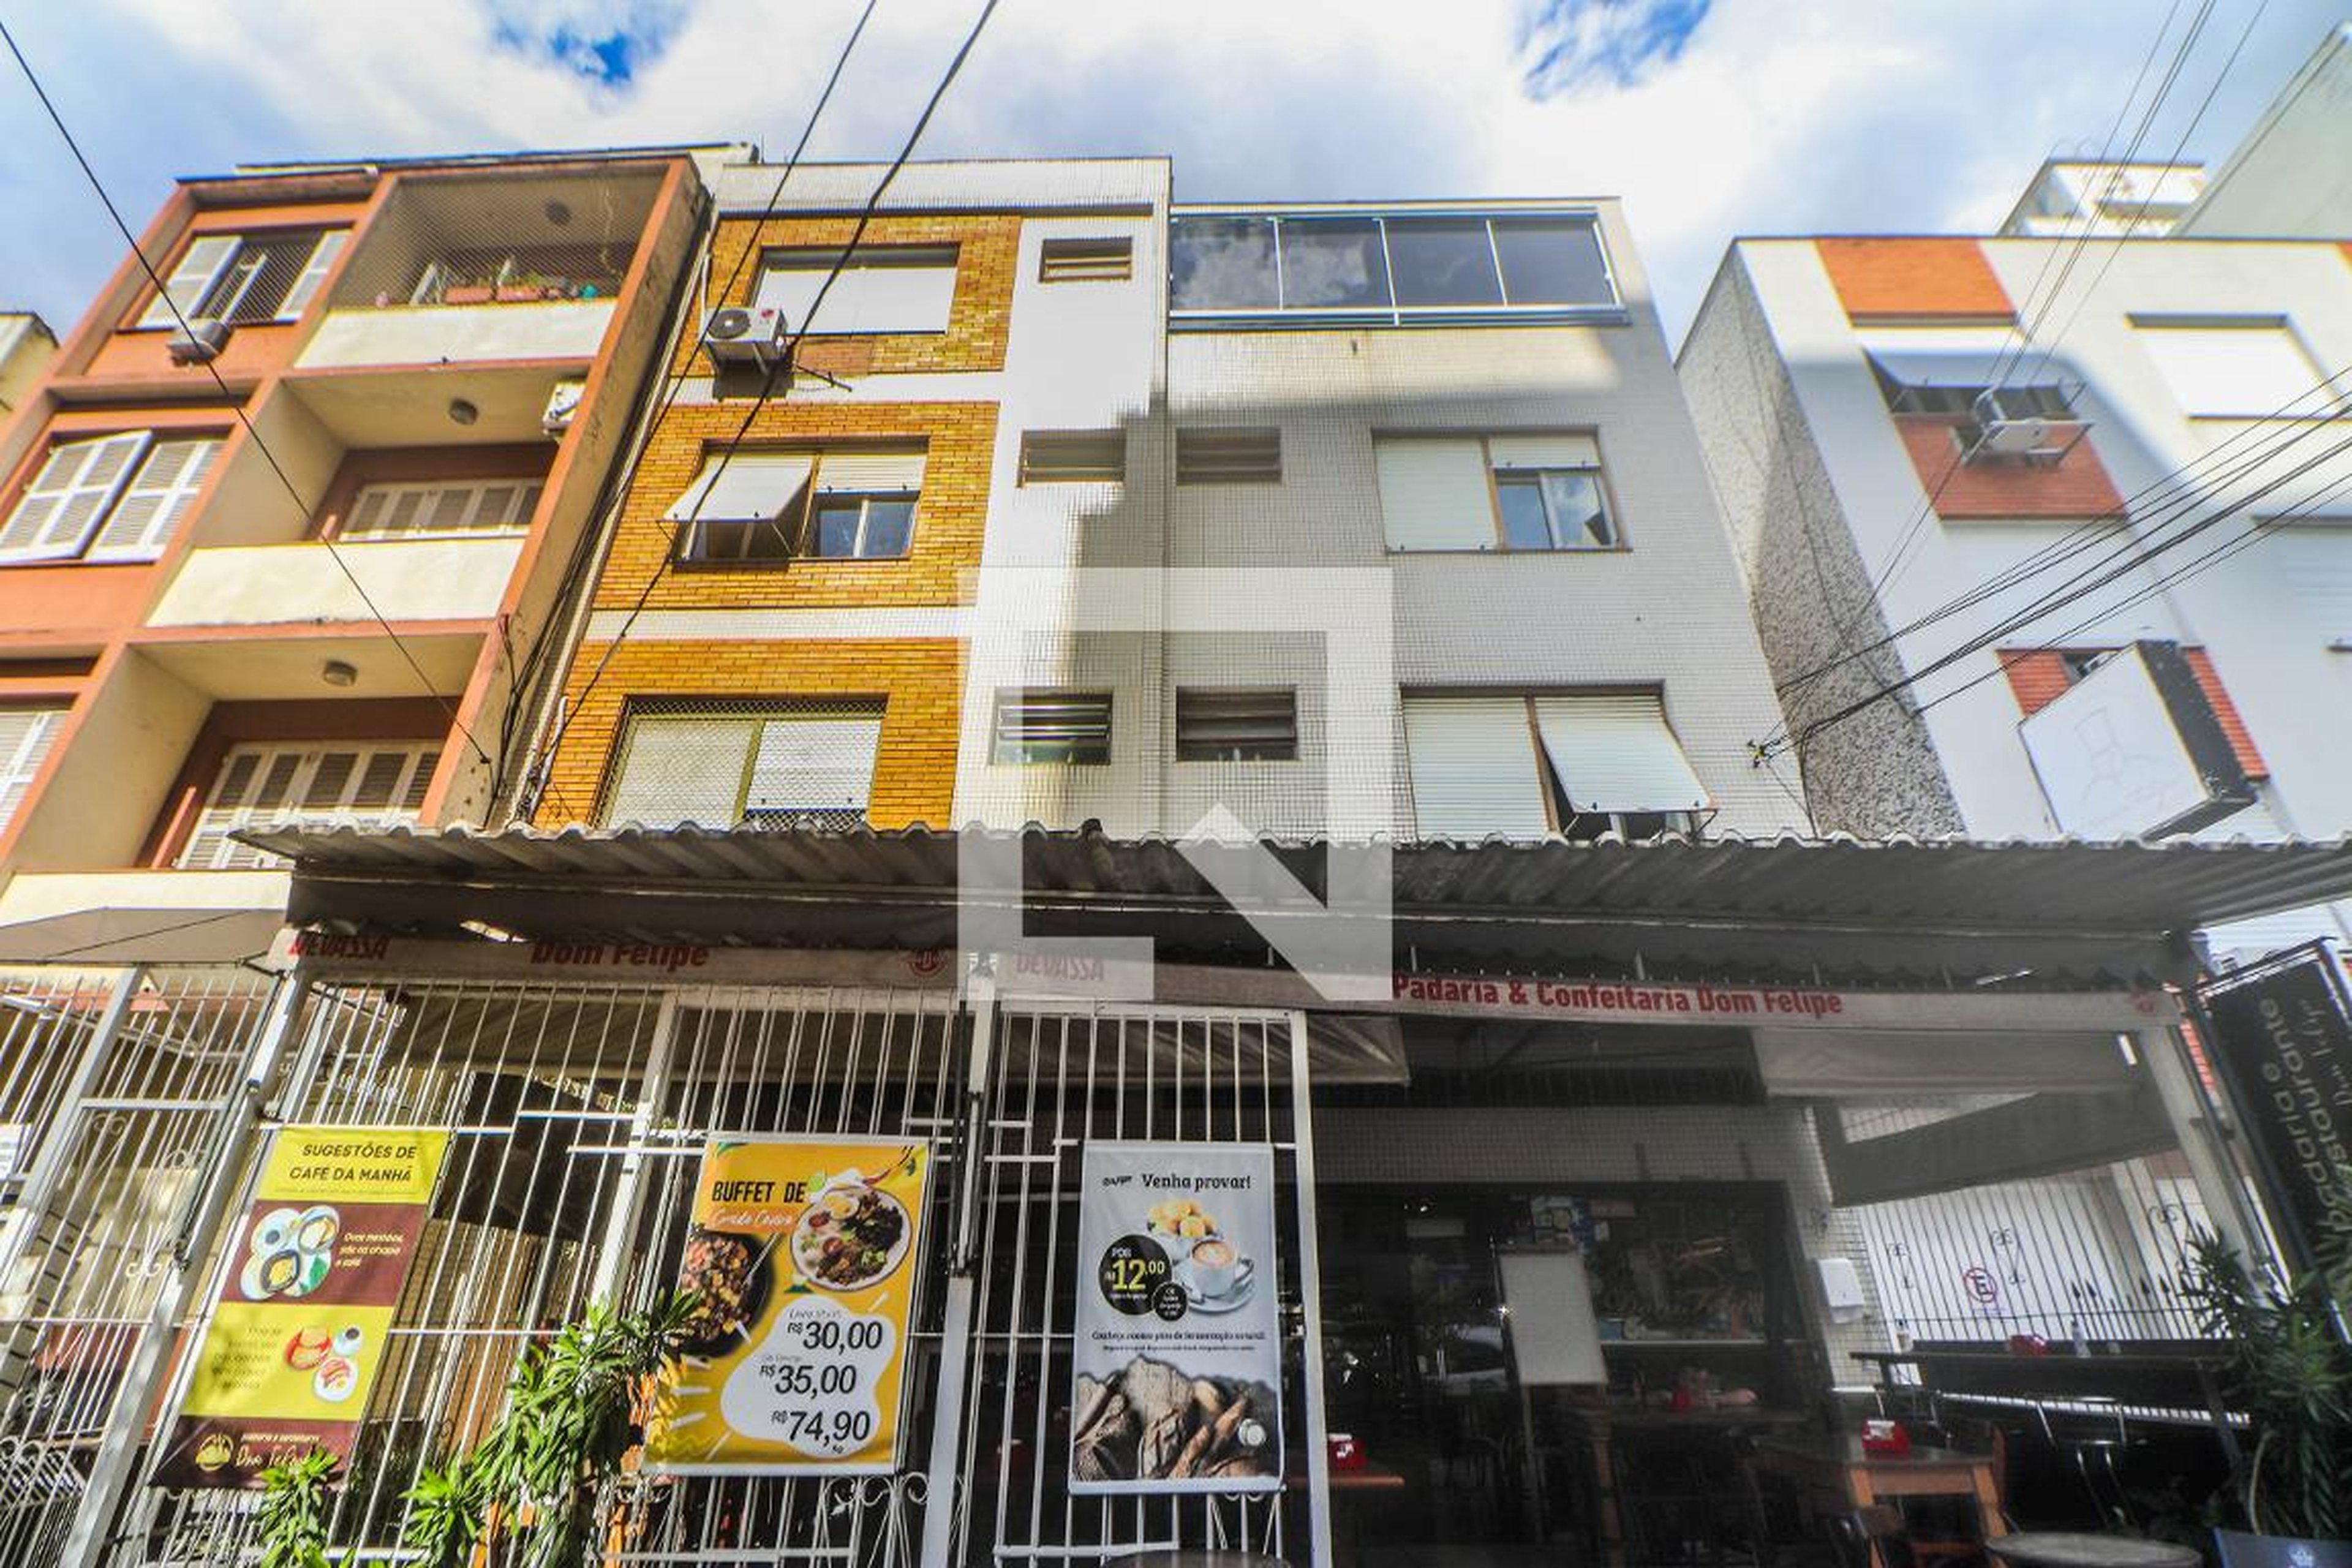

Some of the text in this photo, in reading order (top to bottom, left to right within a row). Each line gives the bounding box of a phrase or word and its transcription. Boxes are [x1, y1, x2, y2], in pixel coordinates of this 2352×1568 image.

[530, 940, 604, 965] Dom
[1392, 976, 1842, 1020] Padaria & Confeitaria Dom Felipe
[303, 1141, 418, 1159] SUGESTÕES DE
[333, 1167, 355, 1181] DA
[1142, 1173, 1191, 1189] Venha
[1194, 1175, 1251, 1192] provar!
[712, 1181, 808, 1203] BUFFET DE
[803, 1321, 883, 1355] 30,00
[775, 1365, 856, 1399] 35,00
[790, 1411, 870, 1447] 74,90
